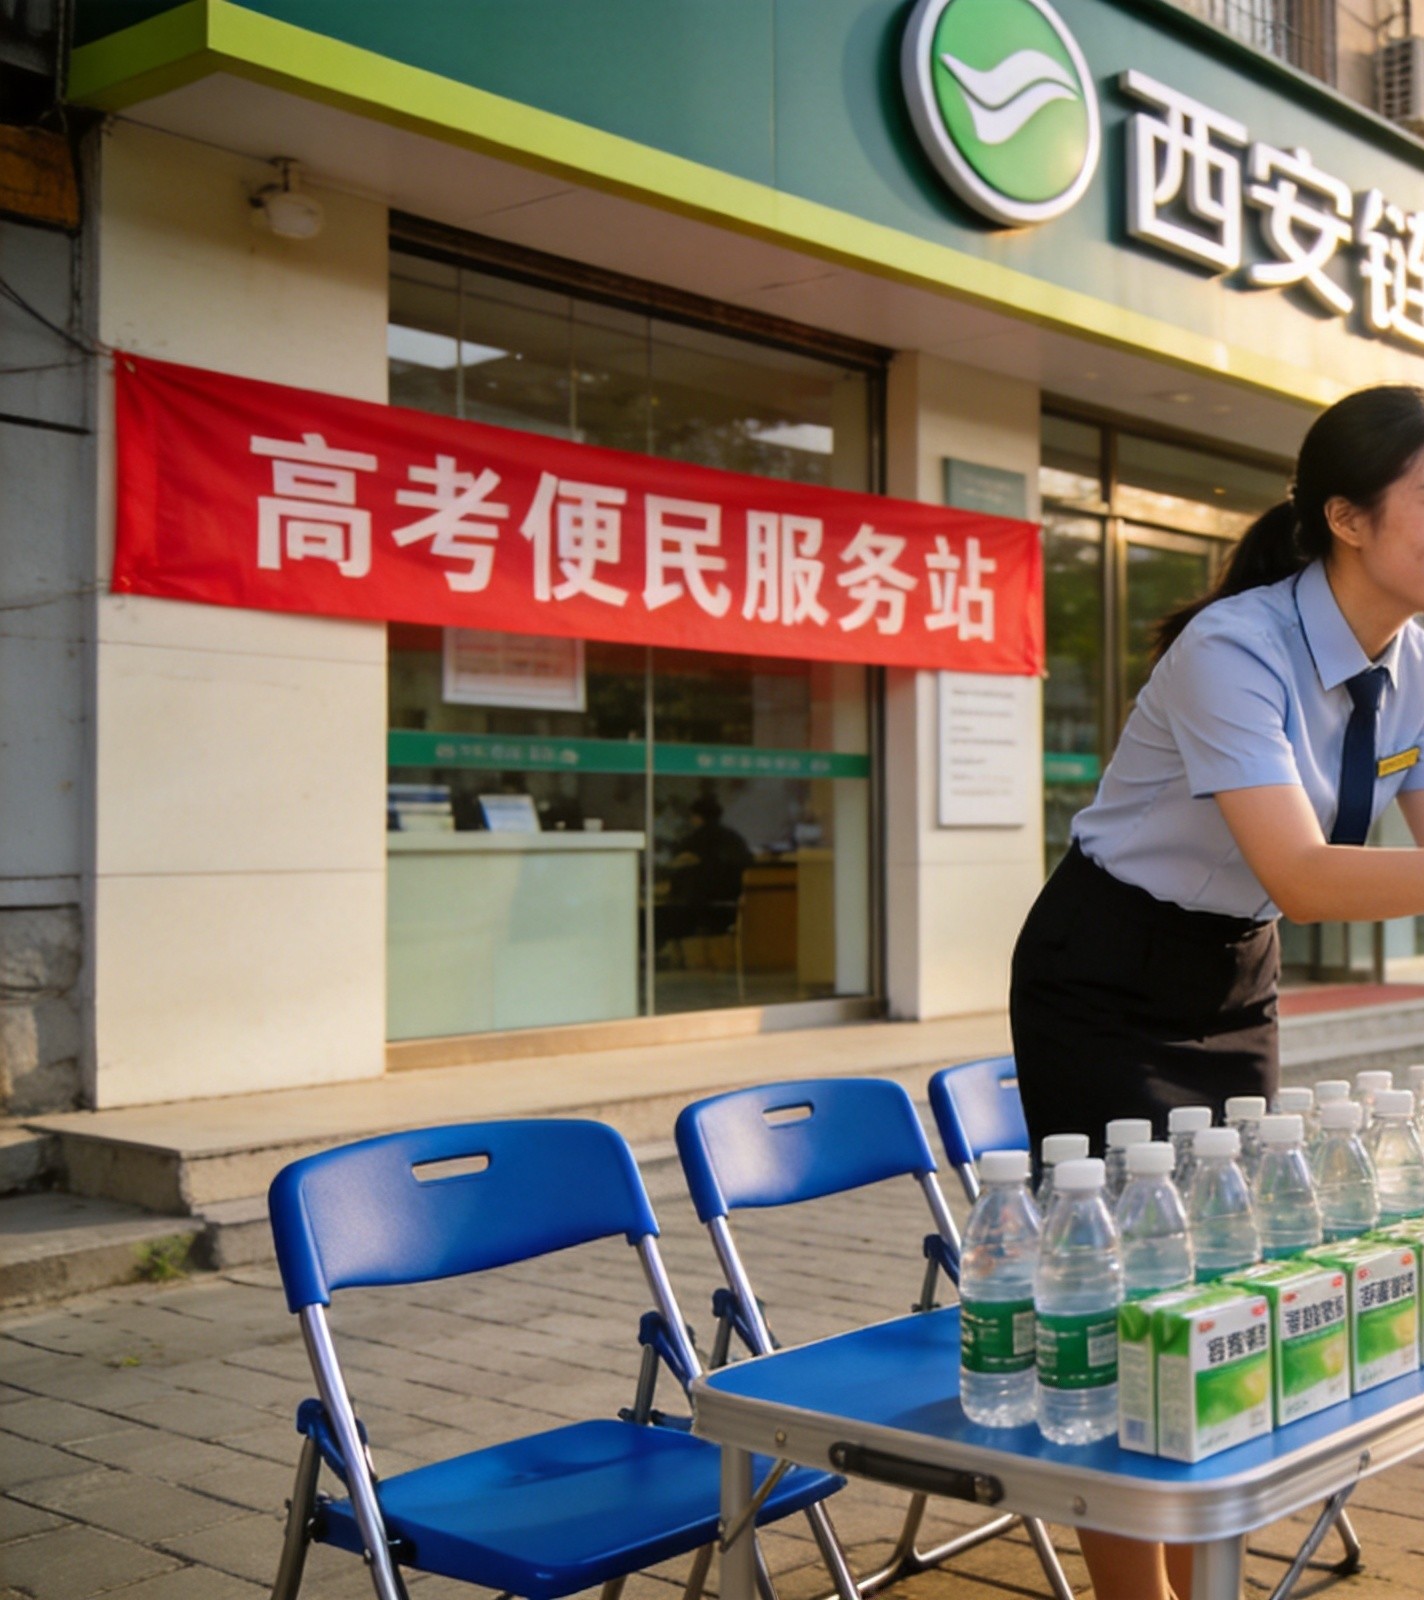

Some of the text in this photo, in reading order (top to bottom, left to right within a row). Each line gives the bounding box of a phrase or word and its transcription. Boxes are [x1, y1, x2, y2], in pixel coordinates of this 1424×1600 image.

[249, 432, 997, 644] 高考便民服务站
